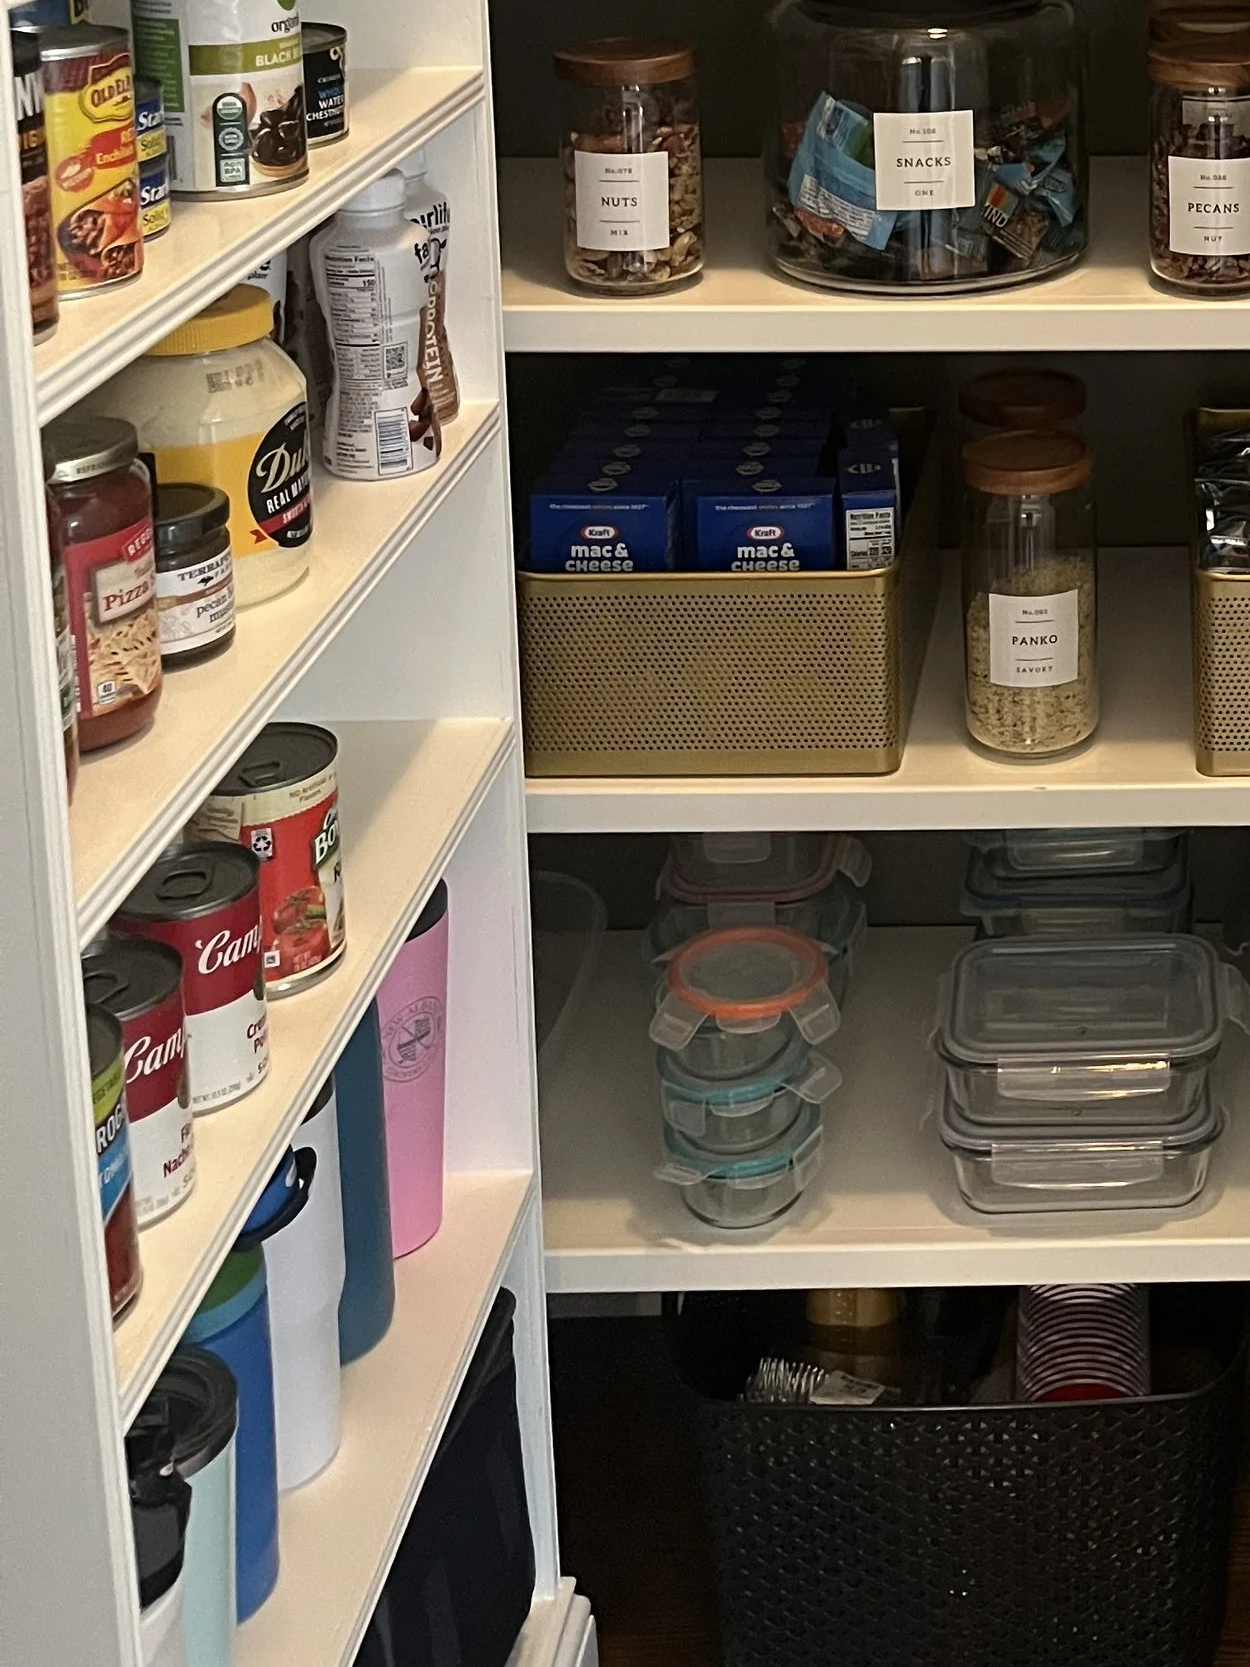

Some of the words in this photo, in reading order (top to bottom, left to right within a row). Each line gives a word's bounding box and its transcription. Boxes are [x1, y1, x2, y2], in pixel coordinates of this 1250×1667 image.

[255, 50, 293, 67] BLACK
[90, 81, 115, 108] OLD
[896, 156, 952, 169] SNACKS
[914, 189, 934, 197] ONE
[600, 196, 638, 207] NUTS
[1187, 202, 1241, 214] PECANS
[1203, 235, 1223, 243] NUT
[266, 489, 292, 514] REAL
[588, 528, 611, 538] Kraft
[754, 528, 777, 537] Kraft
[570, 544, 613, 558] mac
[614, 542, 629, 558] &
[737, 545, 779, 559] mac
[780, 542, 795, 557] &
[104, 579, 149, 613] Pizza
[1011, 634, 1059, 646] PANKO
[1016, 666, 1053, 674] SAVORY
